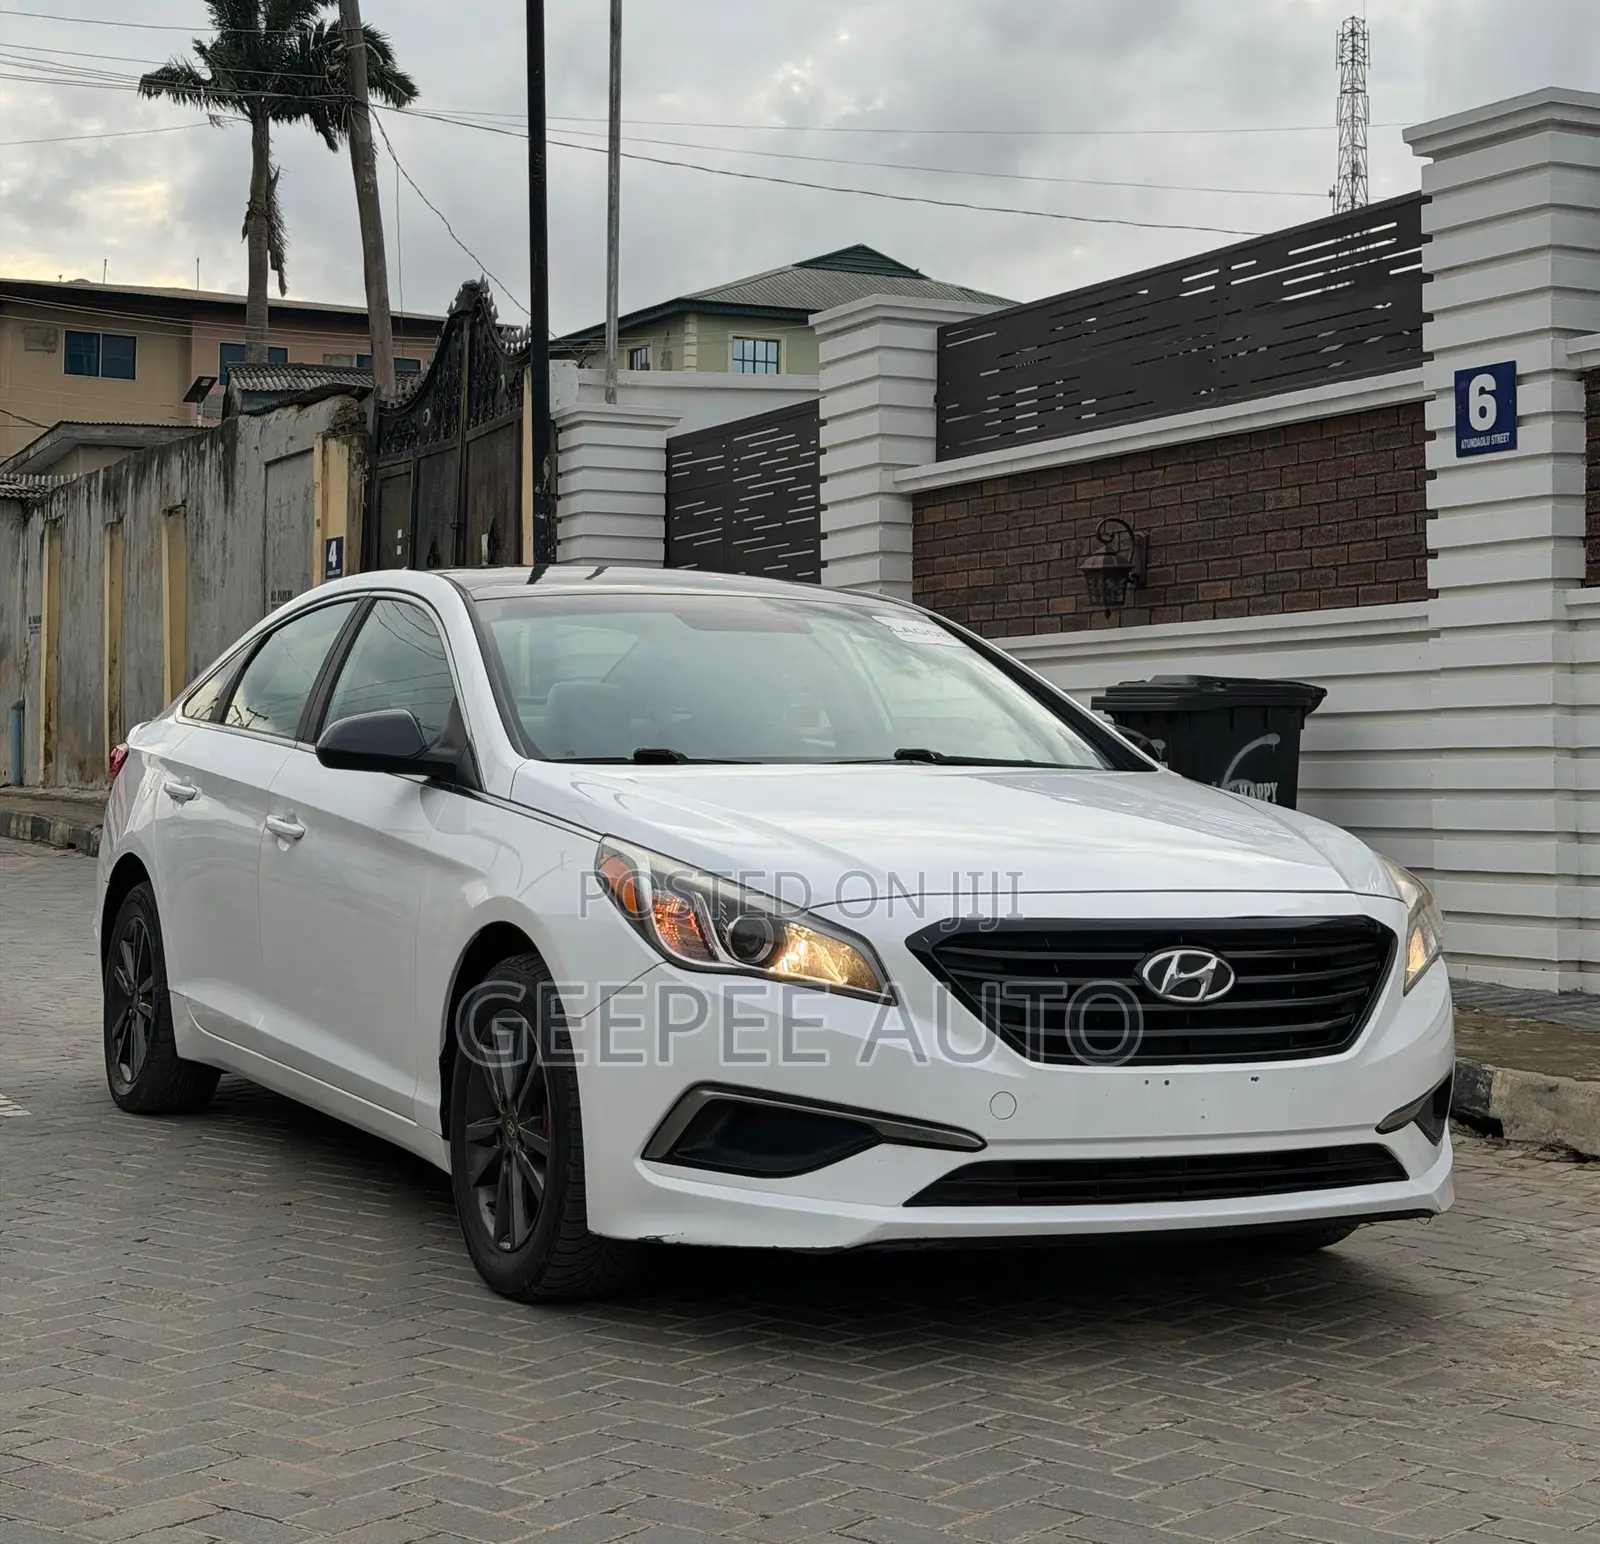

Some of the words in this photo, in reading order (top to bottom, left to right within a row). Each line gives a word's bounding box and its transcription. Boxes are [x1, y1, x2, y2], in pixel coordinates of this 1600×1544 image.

[1468, 373, 1497, 431] 6
[1491, 432, 1510, 445] STREET
[328, 541, 337, 568] 4
